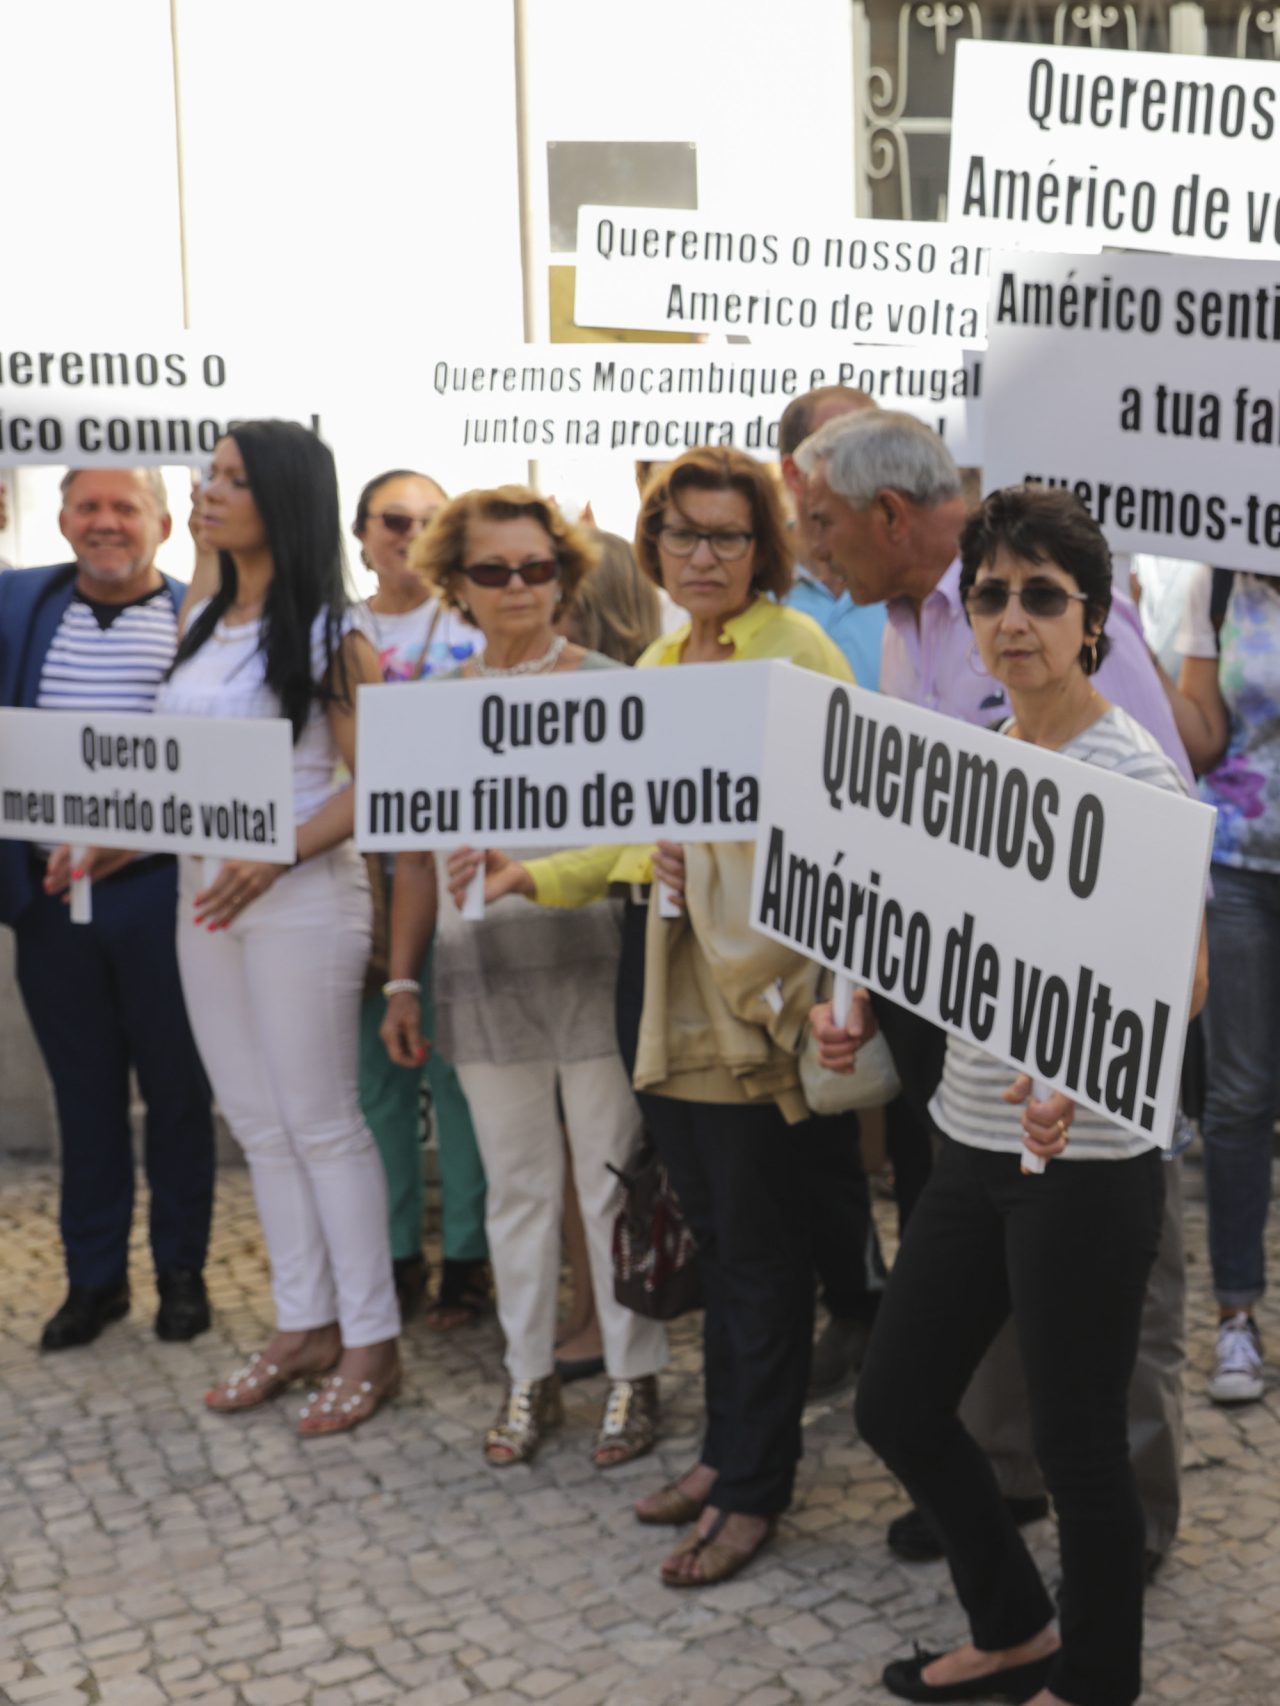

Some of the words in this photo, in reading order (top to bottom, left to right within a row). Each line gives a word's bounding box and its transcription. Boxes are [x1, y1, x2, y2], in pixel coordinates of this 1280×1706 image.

[1028, 58, 1277, 141] Queremos
[962, 155, 1157, 233] Américo
[1171, 174, 1231, 240] de
[597, 219, 778, 265] Queremos
[792, 236, 810, 266] o
[825, 238, 936, 274] nosso
[831, 294, 873, 331] de
[997, 270, 1161, 335] Américo
[203, 354, 226, 387] o
[433, 361, 582, 396] Queremos
[593, 361, 798, 398] Moçambique
[809, 368, 825, 389] e
[838, 363, 981, 401] Portugal
[463, 414, 554, 446] juntos
[566, 419, 600, 445] na
[611, 419, 734, 450] procura
[1120, 386, 1142, 433] a
[1155, 384, 1221, 440] tua
[82, 726, 157, 772] Quero
[166, 737, 180, 772] o
[481, 694, 607, 754] Quero
[621, 695, 645, 742] o
[2, 789, 55, 824] meu
[63, 789, 154, 833] marido
[162, 795, 193, 837] de
[201, 800, 277, 844] volta!
[369, 788, 460, 835] meu
[473, 776, 568, 831] filho
[582, 773, 635, 829] de
[648, 767, 759, 825] volta
[822, 687, 1060, 881] Queremos
[1069, 794, 1105, 899] o
[759, 826, 931, 1006] Américo
[940, 913, 1000, 1042] de
[1010, 958, 1171, 1132] volta!
